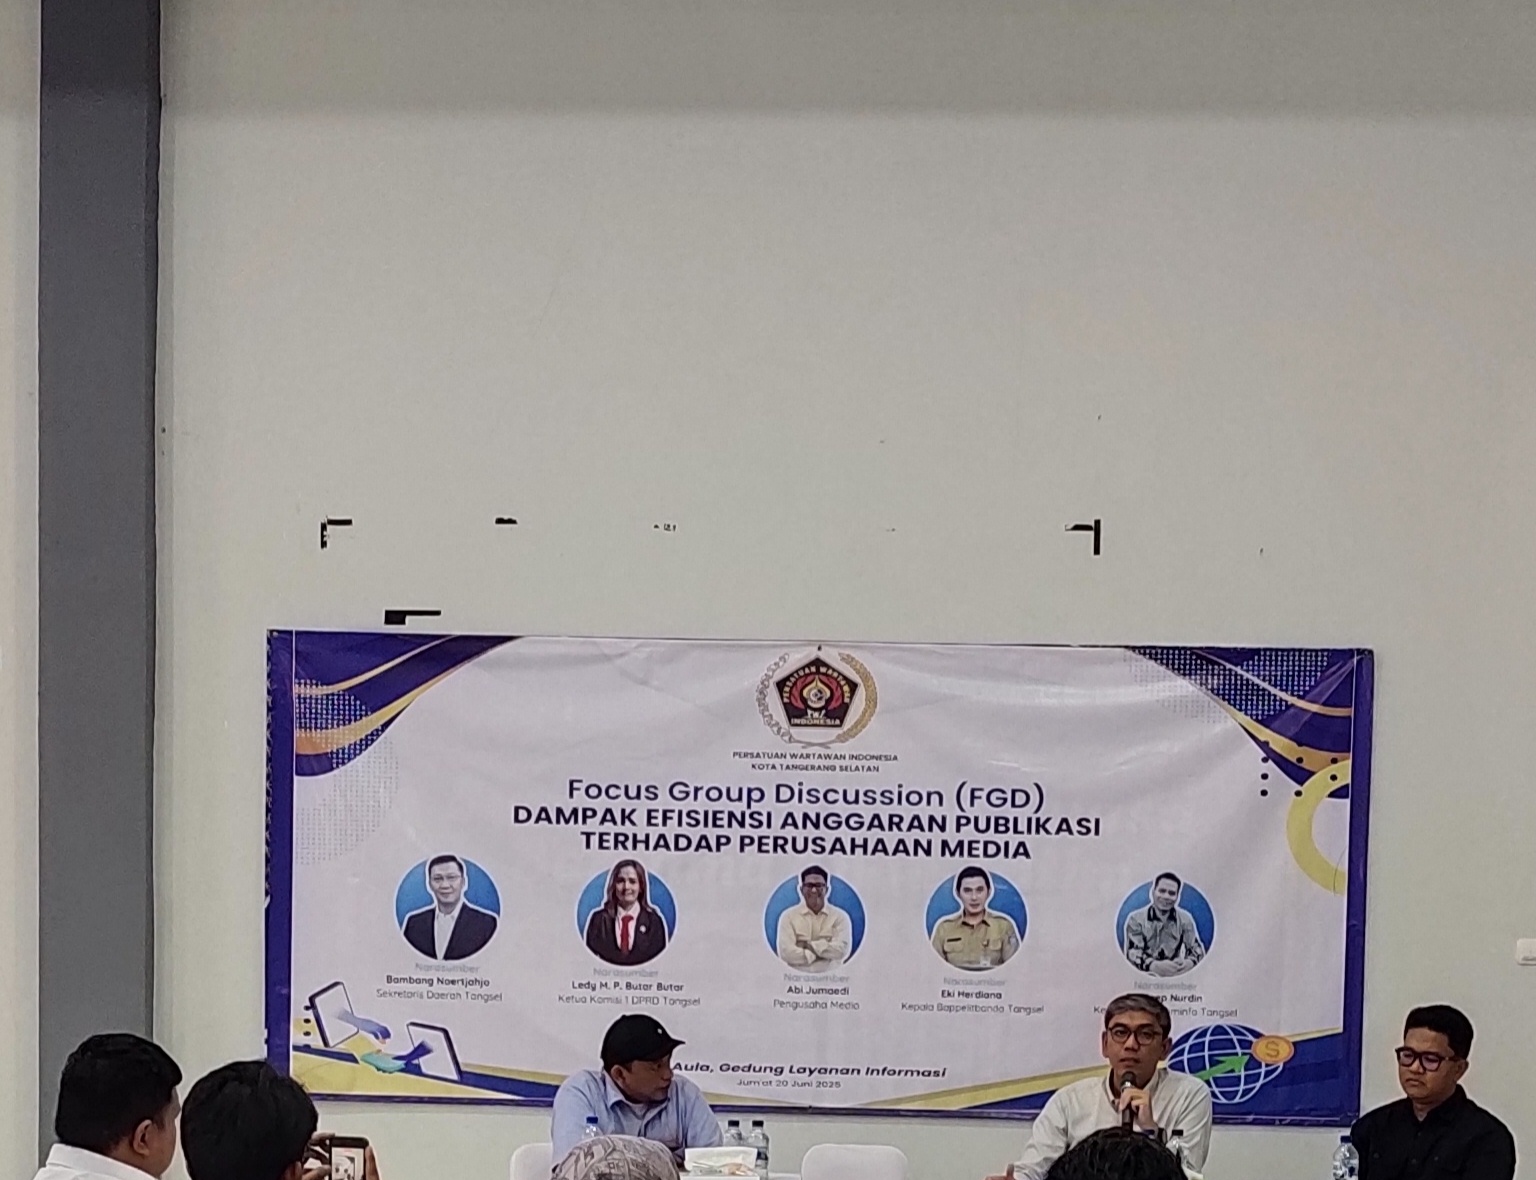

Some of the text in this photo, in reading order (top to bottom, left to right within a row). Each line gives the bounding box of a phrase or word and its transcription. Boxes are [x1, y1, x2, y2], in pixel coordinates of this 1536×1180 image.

[790, 717, 842, 726] INDONESIA
[732, 751, 899, 762] PERSATUAN WARTAWAN INDONESIA
[751, 763, 880, 773] KOTA TANGERANG SELATAN
[568, 779, 1045, 814] Focus Group Discussion (FGD)
[513, 805, 1101, 836] DAMPAK EFISIENSI ANGGARAN PUBLIKASI
[580, 831, 1032, 859] TERHADAP PERUSAHAAN MEDIA
[415, 963, 480, 974] Narasumber
[386, 975, 490, 989] Bambang Noertjahjo
[783, 973, 850, 983] Narasumber
[572, 981, 684, 992] Ledy M. P. Butar Butar
[787, 985, 850, 996] Abi Jumaedi
[376, 989, 503, 1003] Sekretaris Daerah Tangsel
[941, 989, 1003, 1000] Eki Herdiana
[1170, 994, 1203, 1003] Nurdin
[558, 994, 587, 1004] Ketua
[589, 995, 622, 1005] Komisi
[631, 996, 660, 1006] DPRD
[662, 997, 701, 1008] Tangsel
[773, 999, 860, 1011] Pengusaha Media
[901, 1002, 935, 1013] Kepala
[1008, 1004, 1045, 1016] Tangsel
[1201, 1007, 1238, 1019] Tangsel
[672, 1062, 947, 1078] Aula, Gedung Layanan Informasi
[791, 1079, 813, 1088] Juni
